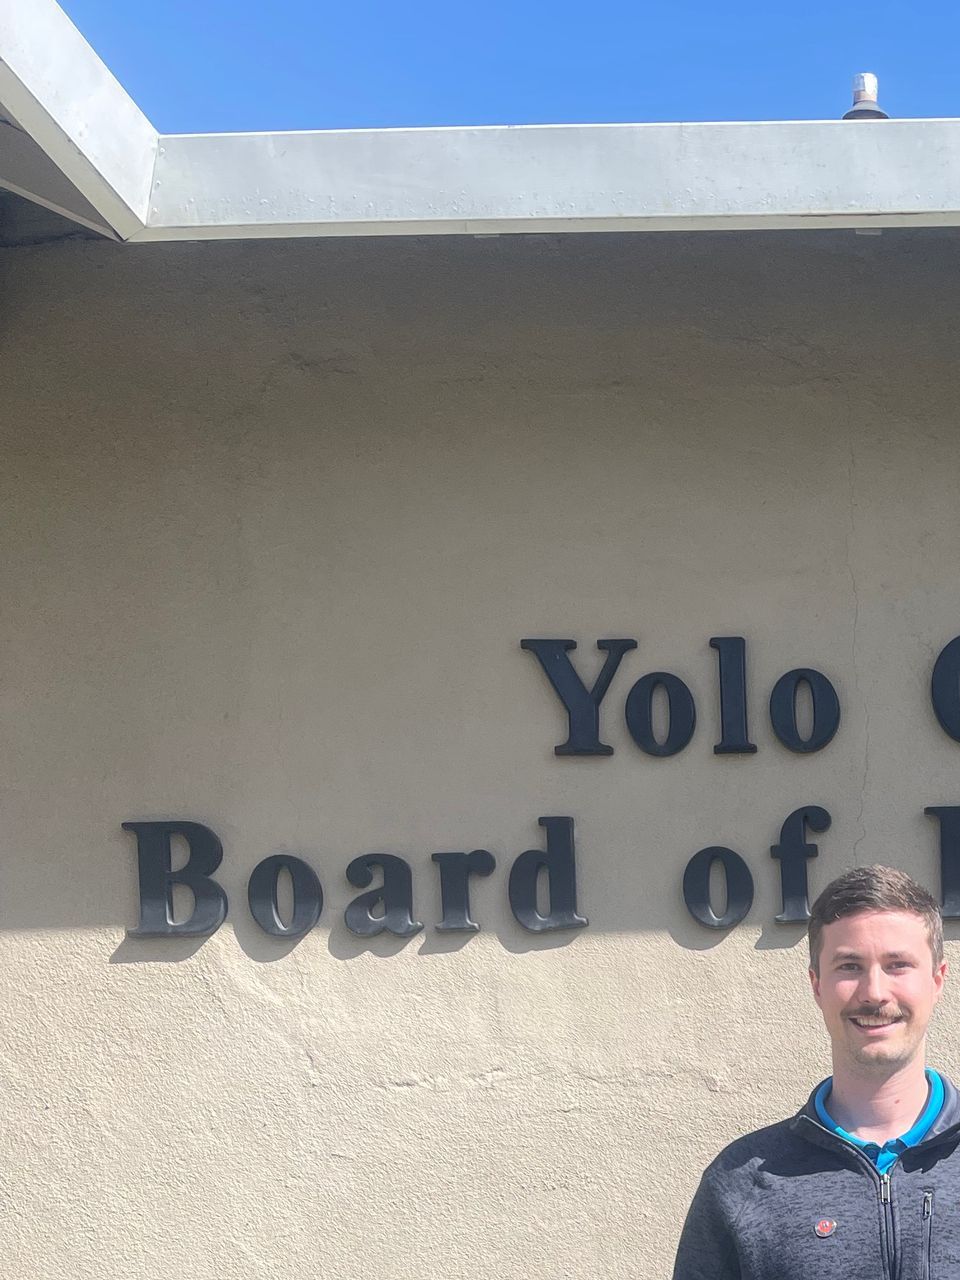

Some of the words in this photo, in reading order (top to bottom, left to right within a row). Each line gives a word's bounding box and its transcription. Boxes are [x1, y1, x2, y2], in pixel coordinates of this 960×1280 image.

[520, 635, 842, 757] Yolo
[121, 816, 589, 938] Board
[682, 805, 832, 929] of
